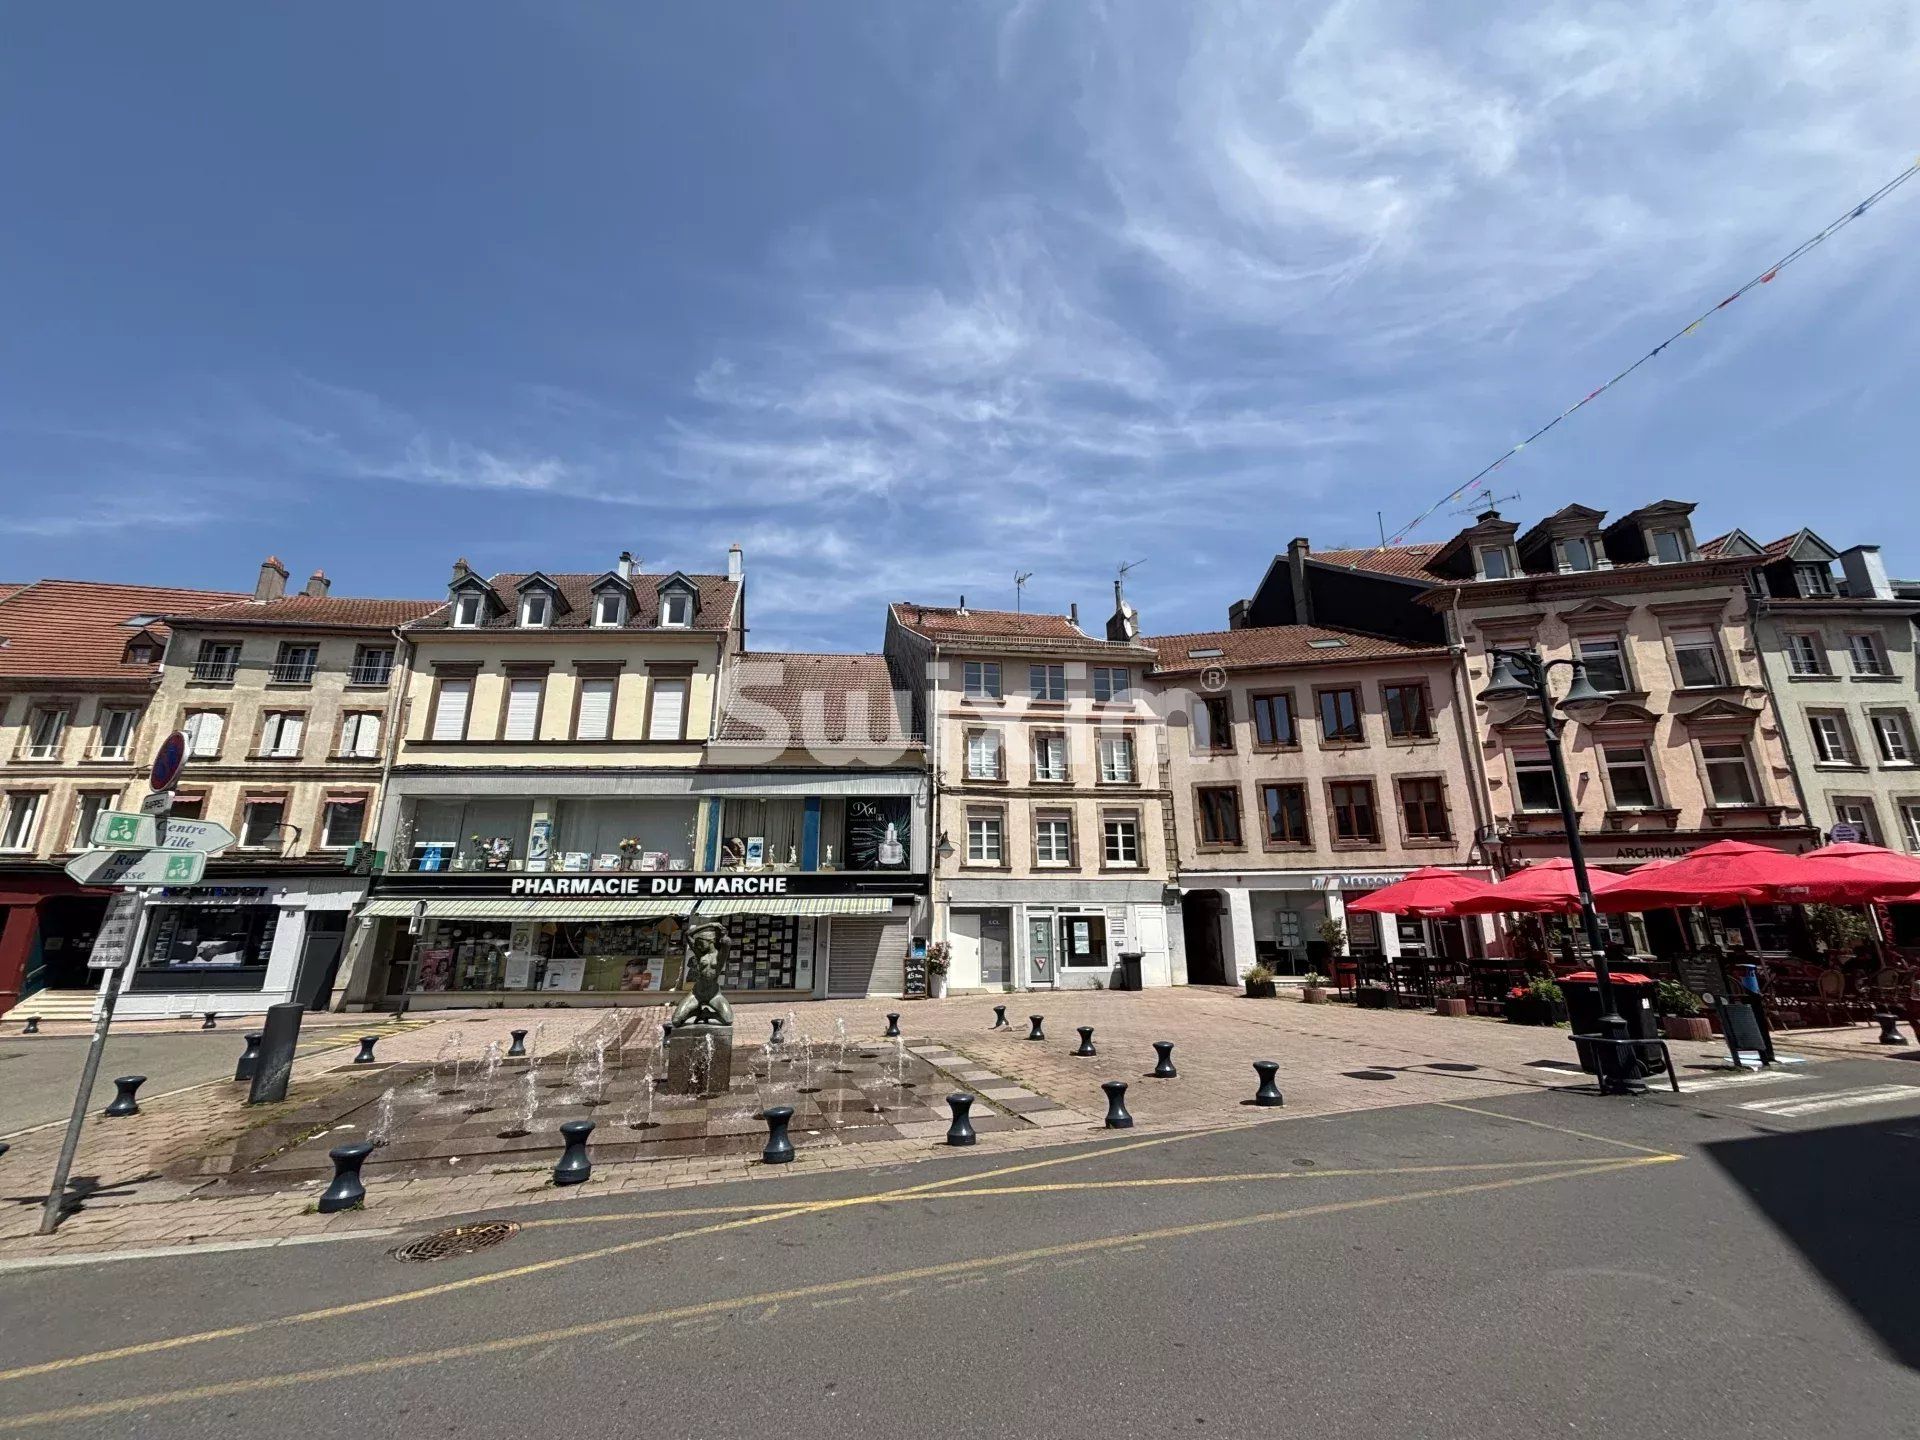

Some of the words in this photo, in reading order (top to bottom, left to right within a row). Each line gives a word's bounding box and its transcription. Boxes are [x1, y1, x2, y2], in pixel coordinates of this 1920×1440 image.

[157, 820, 207, 835] Centre
[164, 836, 195, 848] Ville
[113, 854, 143, 866] Rue
[102, 868, 146, 880] Basse
[511, 878, 640, 894] PHARMACIE
[651, 878, 683, 894] DU
[694, 877, 787, 893] MARCHE
[1340, 874, 1405, 890] Manpowe
